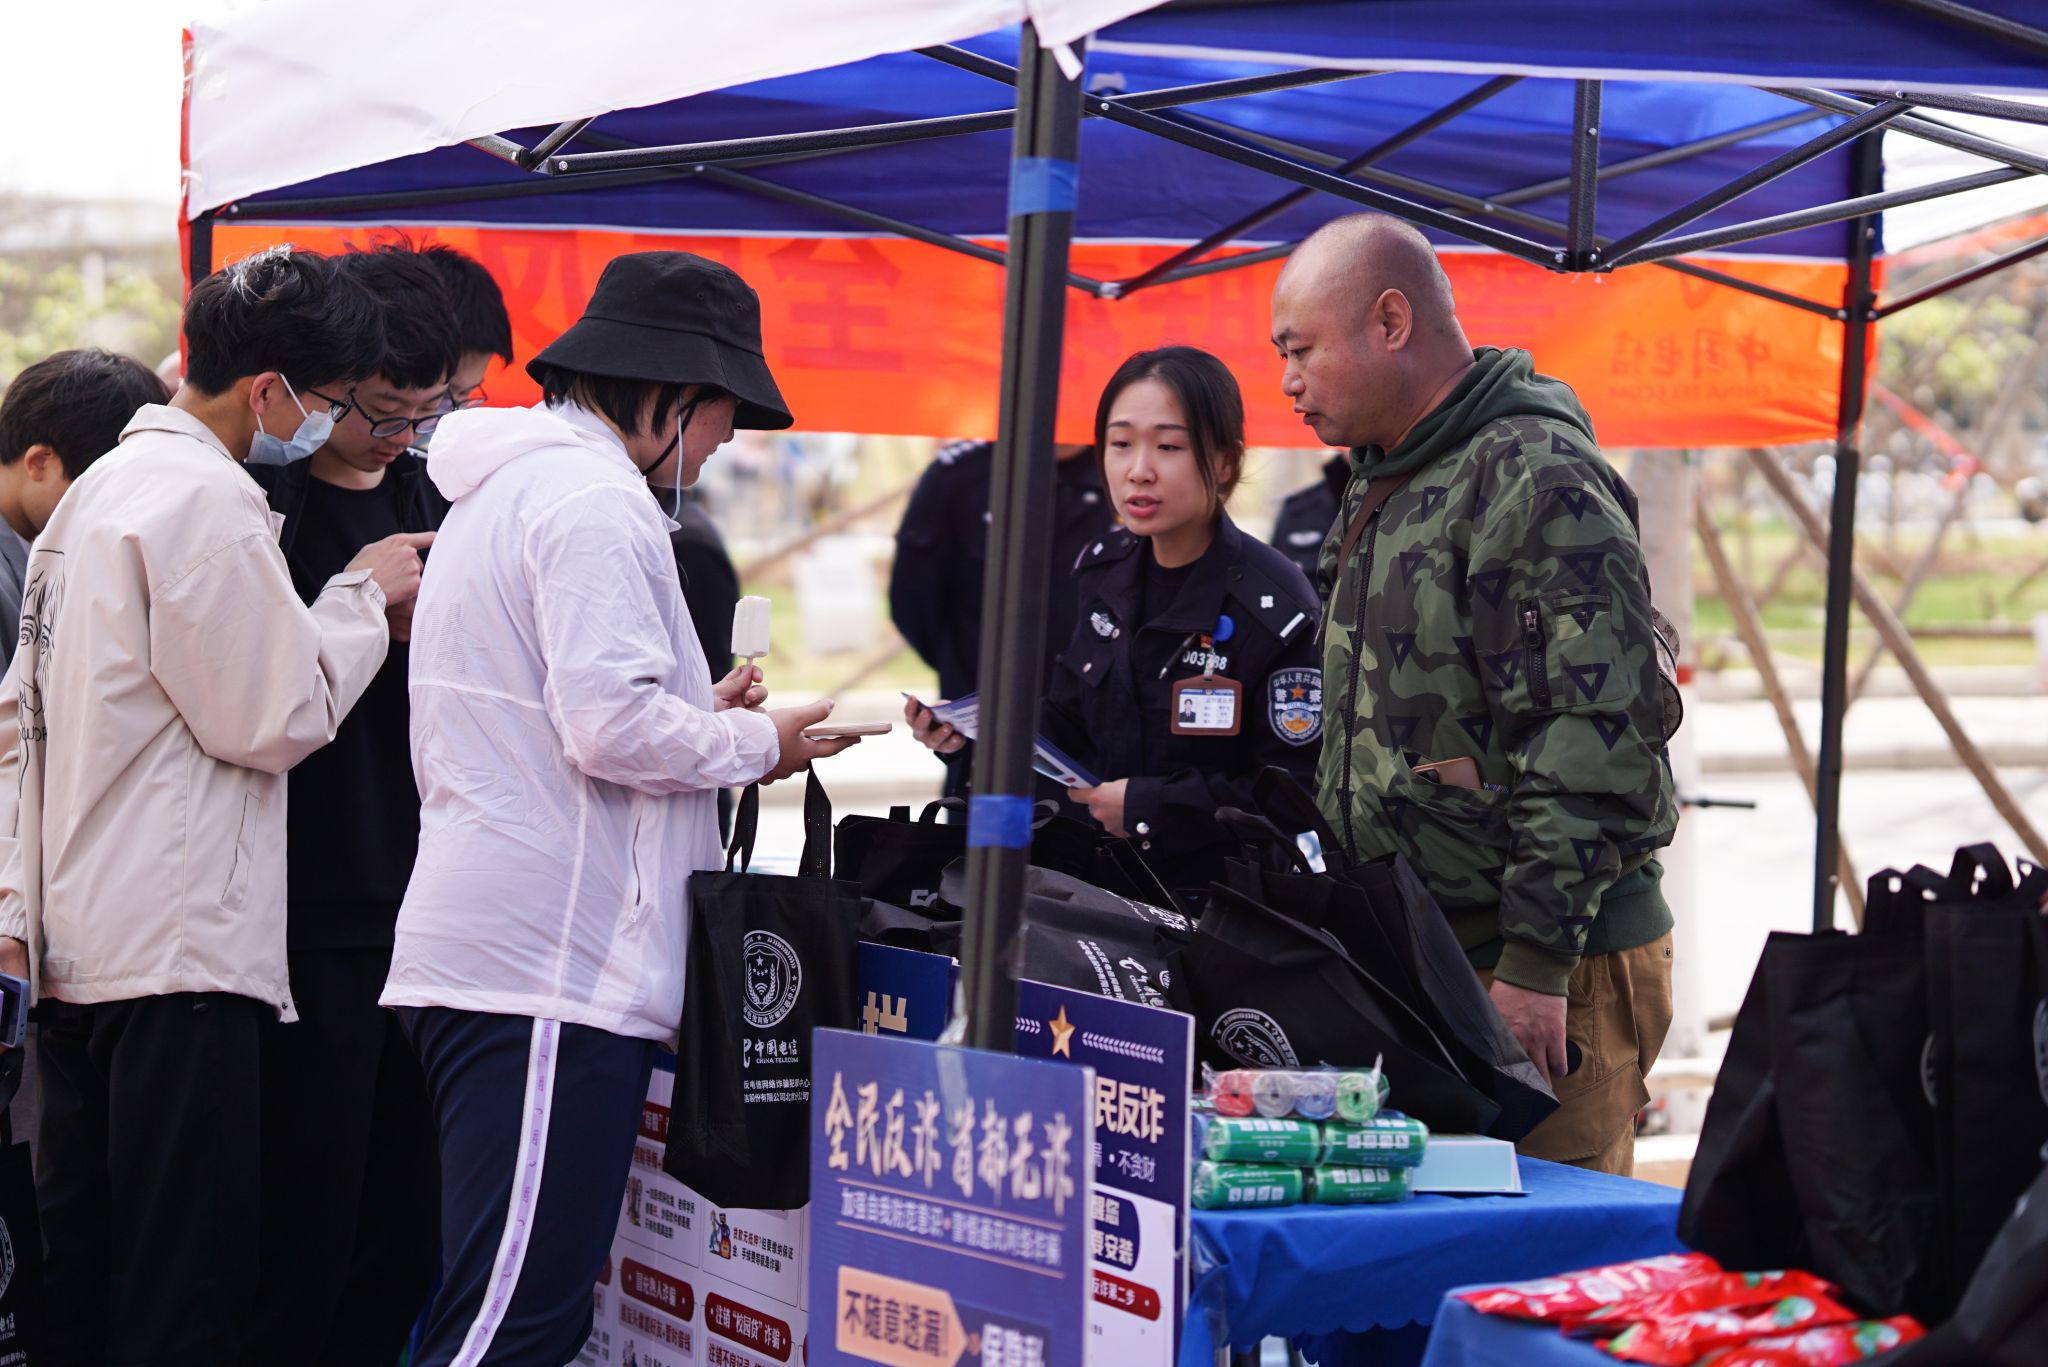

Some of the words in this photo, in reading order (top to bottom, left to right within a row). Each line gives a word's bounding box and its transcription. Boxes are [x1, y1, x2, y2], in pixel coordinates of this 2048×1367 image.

[754, 1037, 798, 1058] 中国电信
[1095, 1075, 1166, 1144] 民反诈
[1091, 1278, 1136, 1306] 反诈第二步
